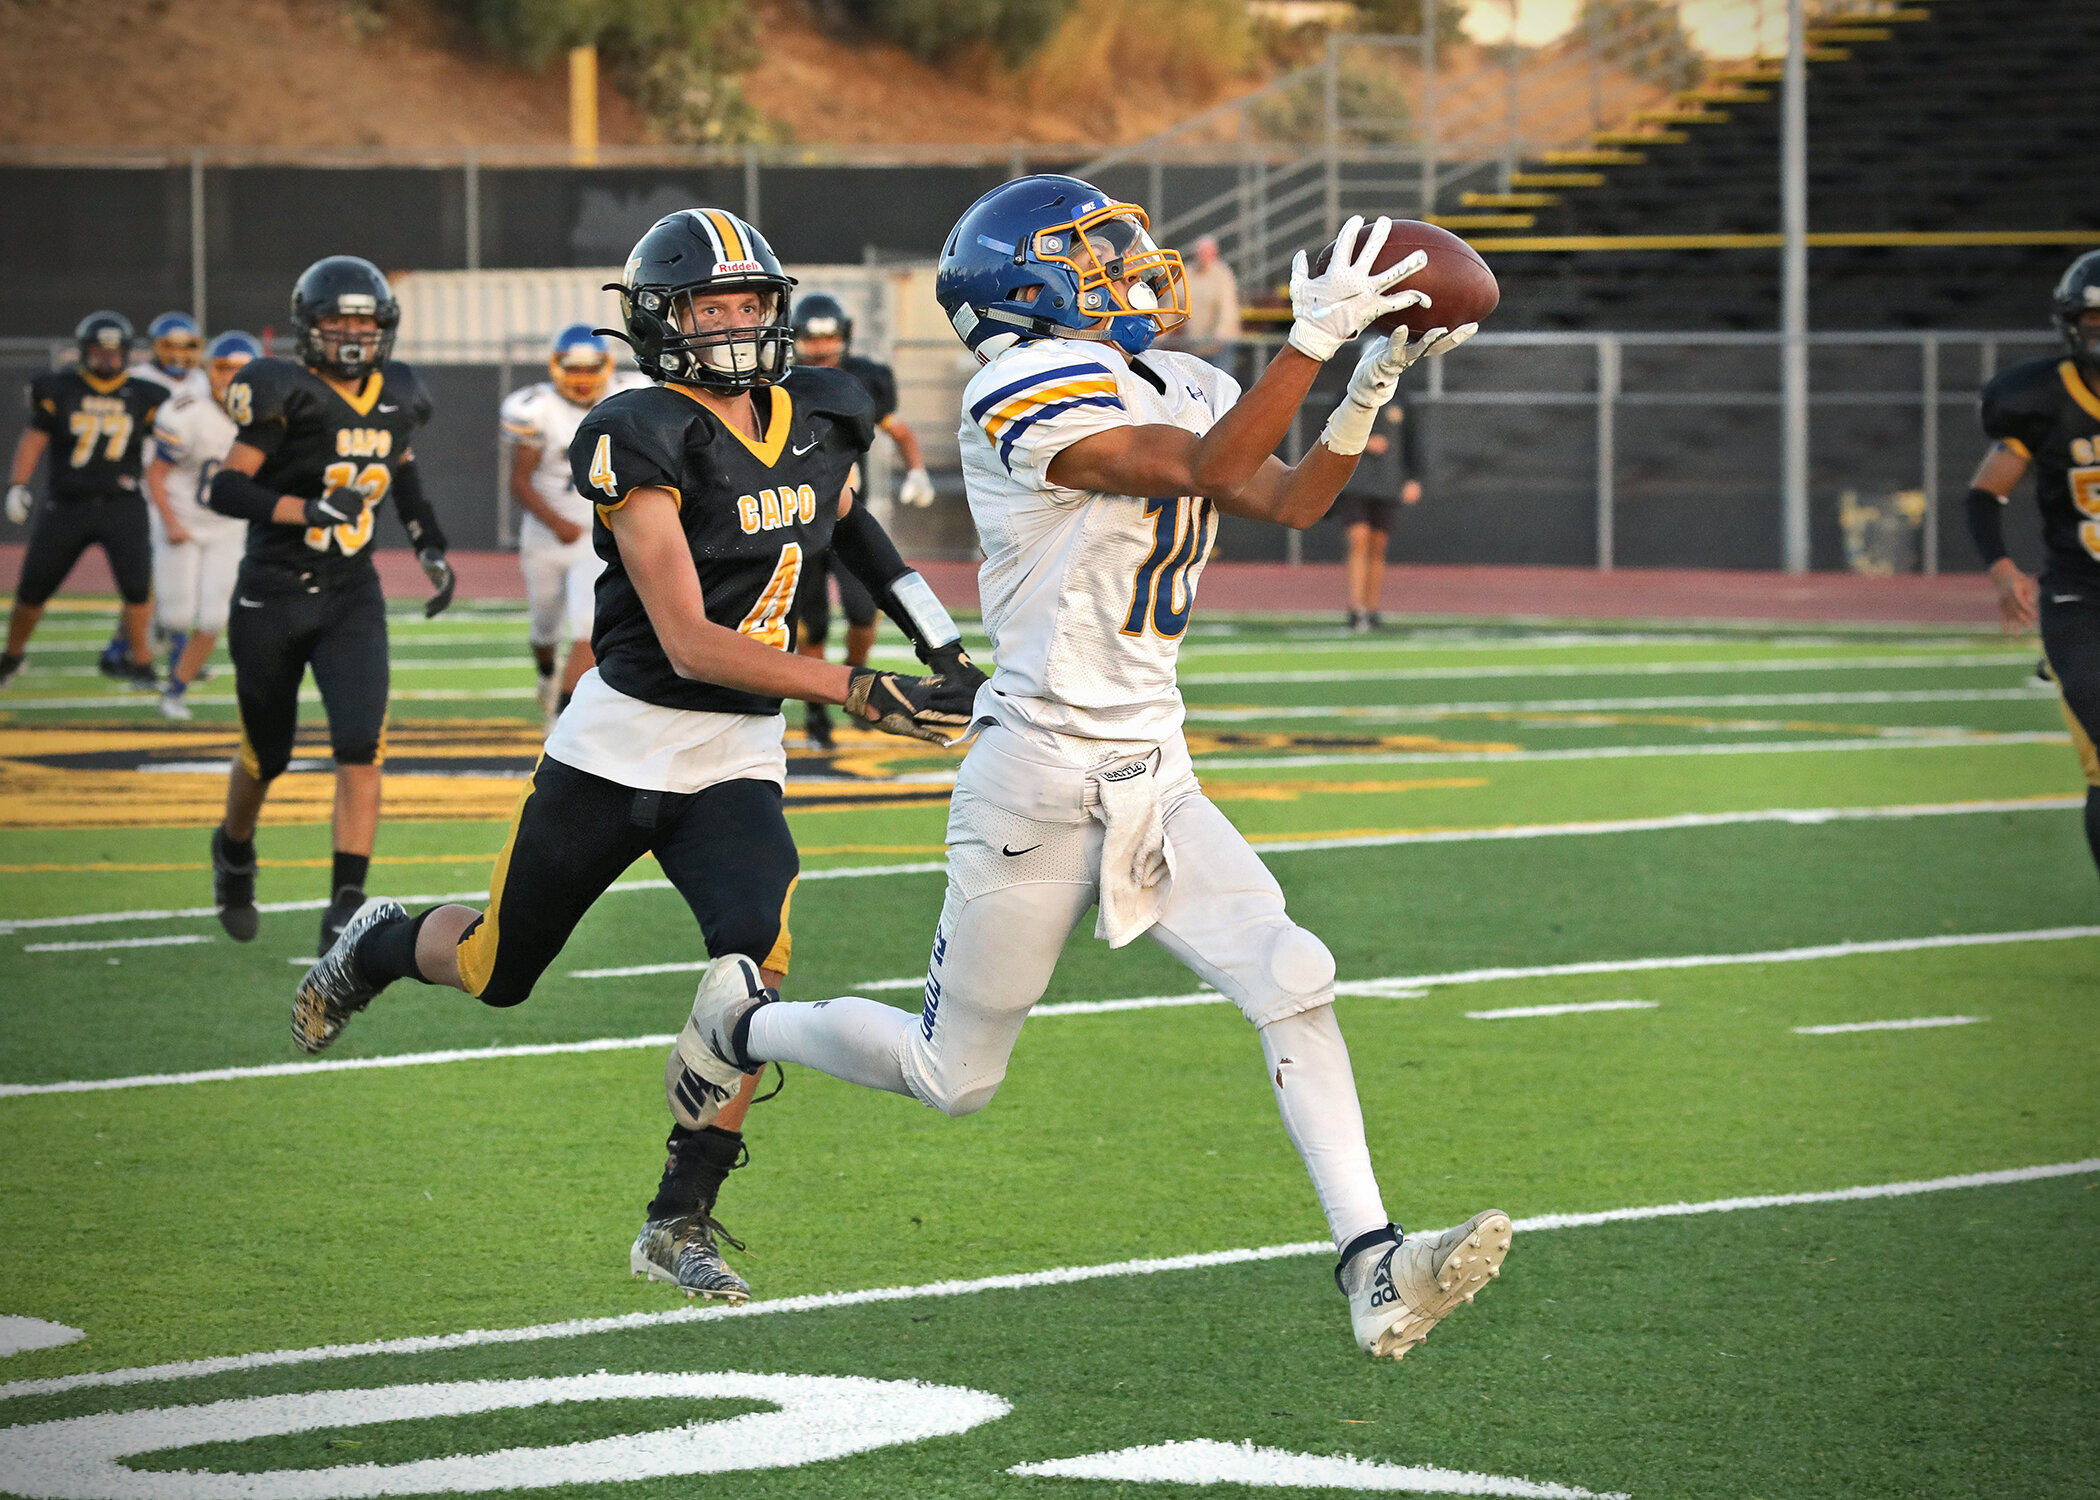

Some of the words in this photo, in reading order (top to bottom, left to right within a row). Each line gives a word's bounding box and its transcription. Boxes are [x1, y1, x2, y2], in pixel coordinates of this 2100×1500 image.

[70, 411, 134, 469] 77
[589, 433, 619, 497] 4
[737, 484, 816, 535] CAPO
[736, 542, 803, 652] 4
[1119, 497, 1212, 641] 10
